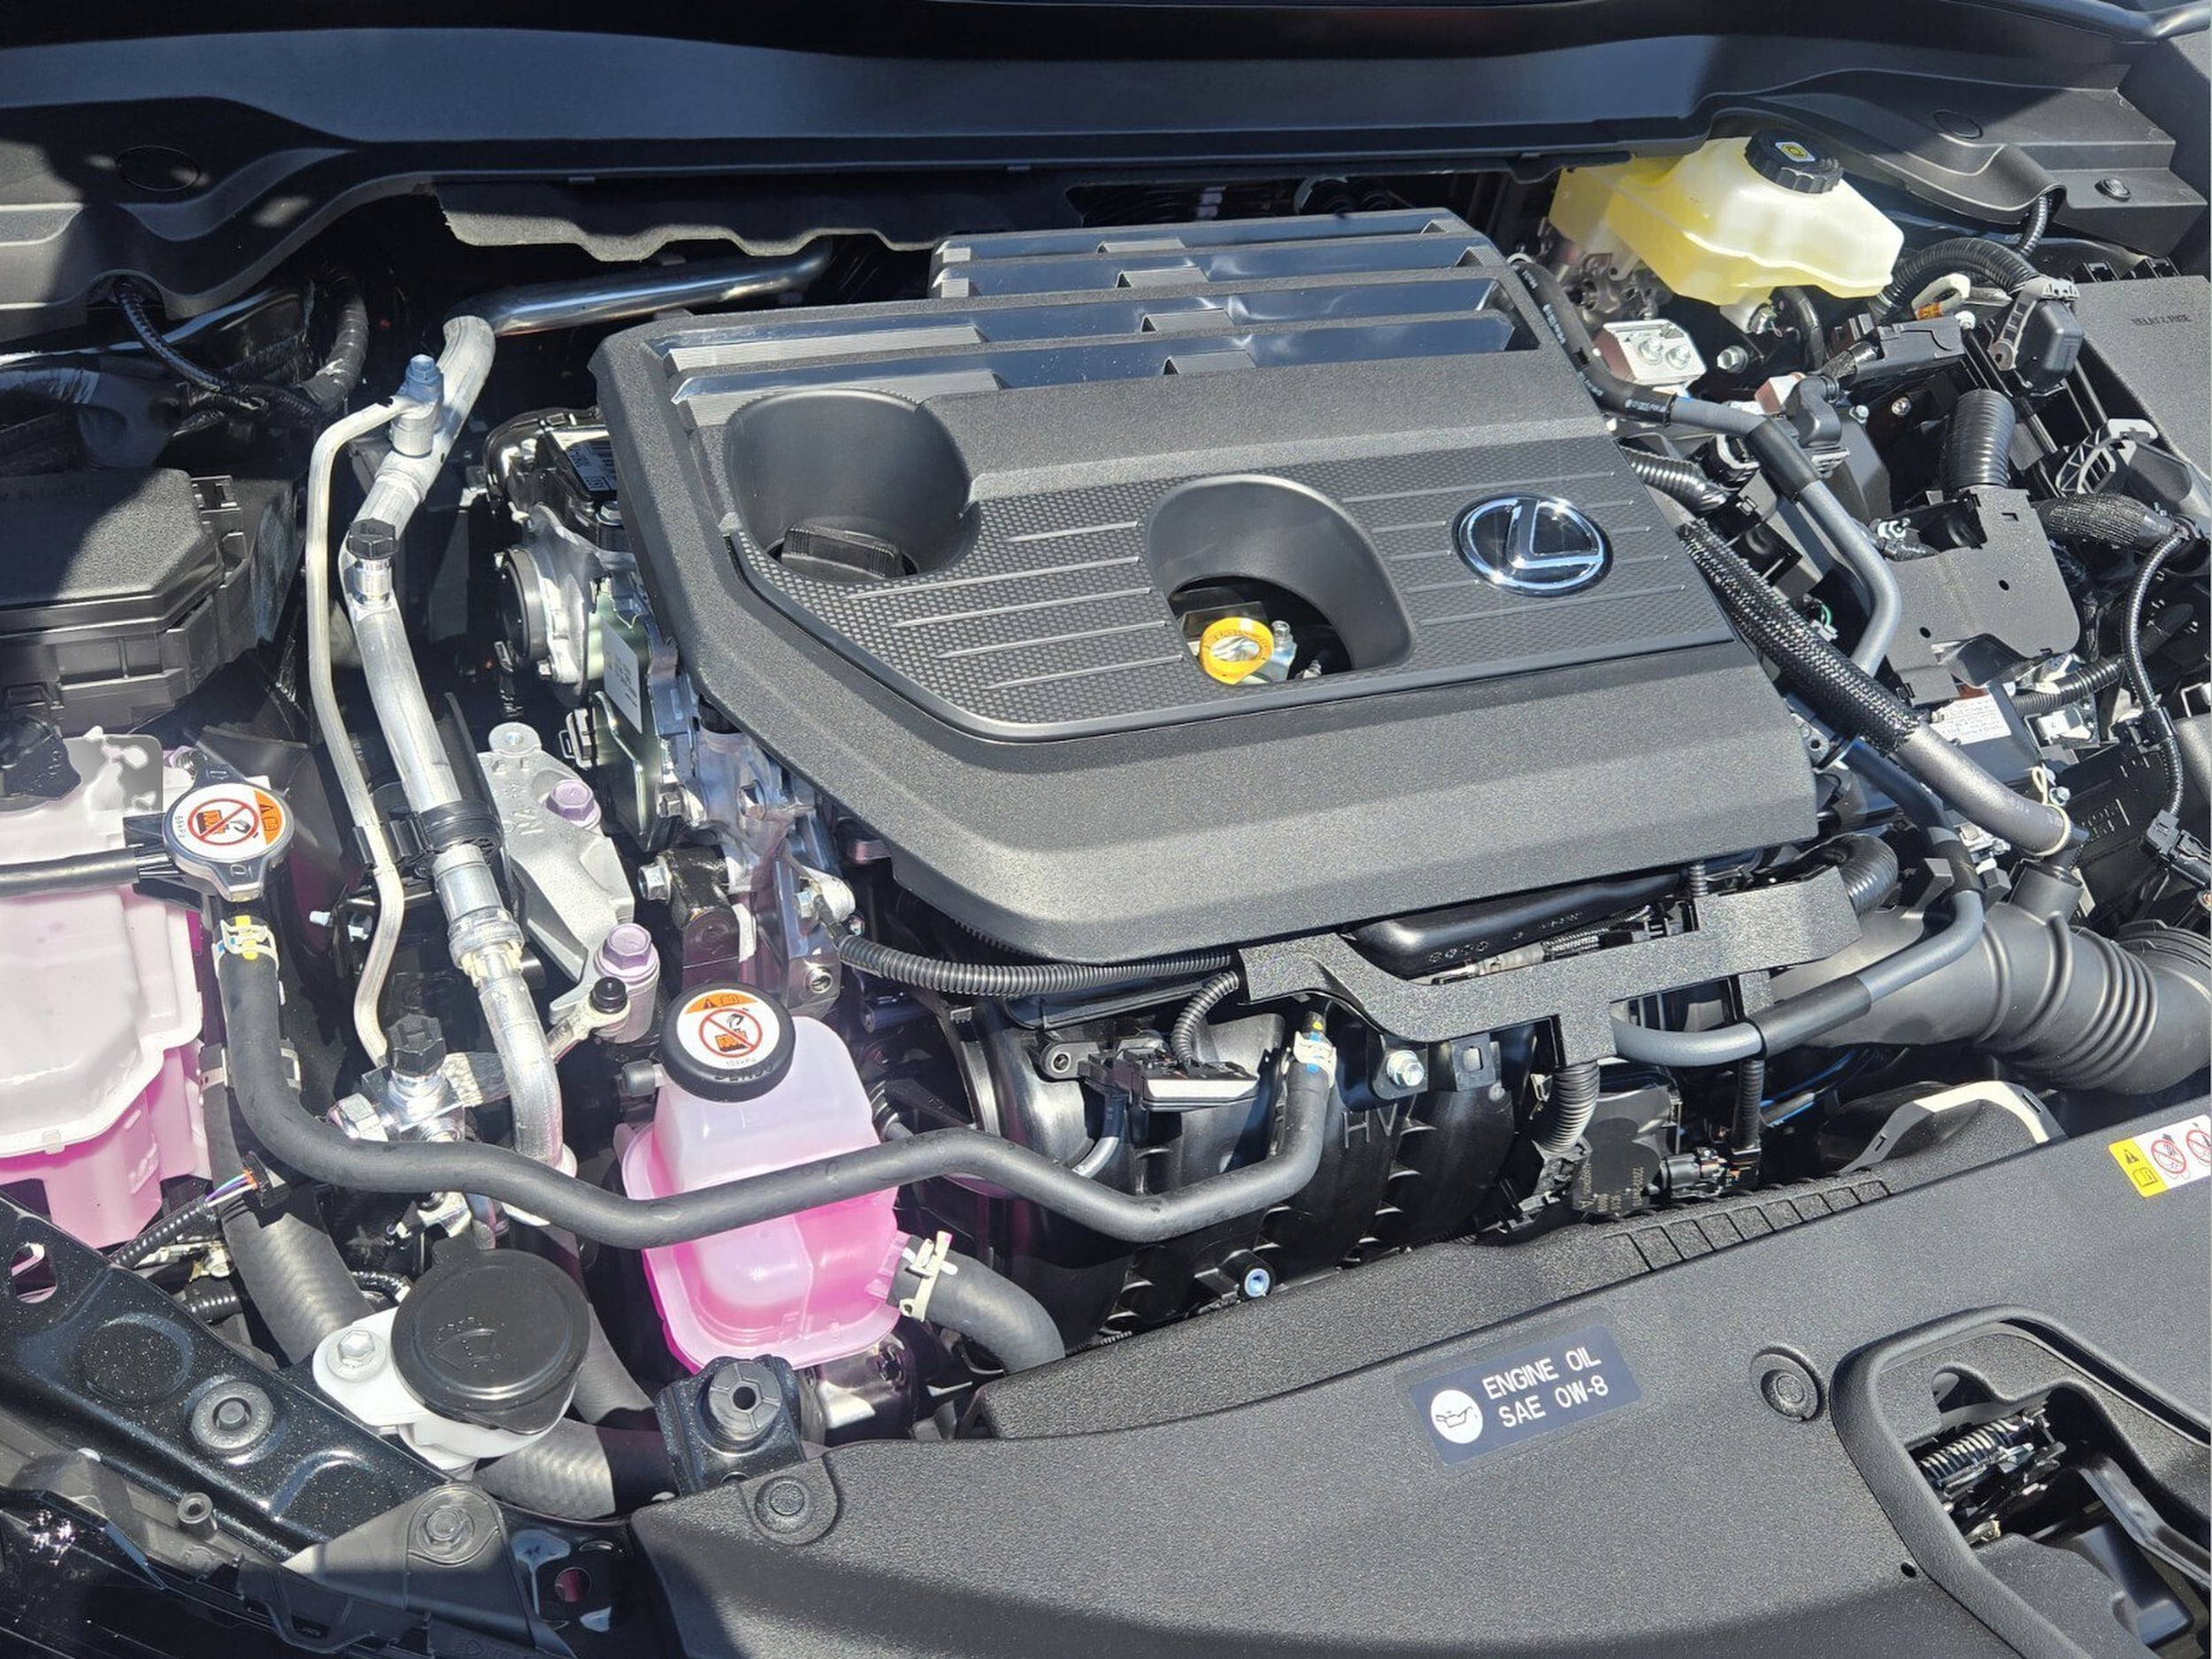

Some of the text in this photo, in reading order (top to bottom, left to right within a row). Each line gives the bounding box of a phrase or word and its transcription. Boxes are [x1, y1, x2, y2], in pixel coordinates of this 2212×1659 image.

[1343, 1102, 1398, 1148] HV
[1482, 1347, 1602, 1400] ENGINE OIL
[1499, 1375, 1609, 1428] SAE 0W-8
